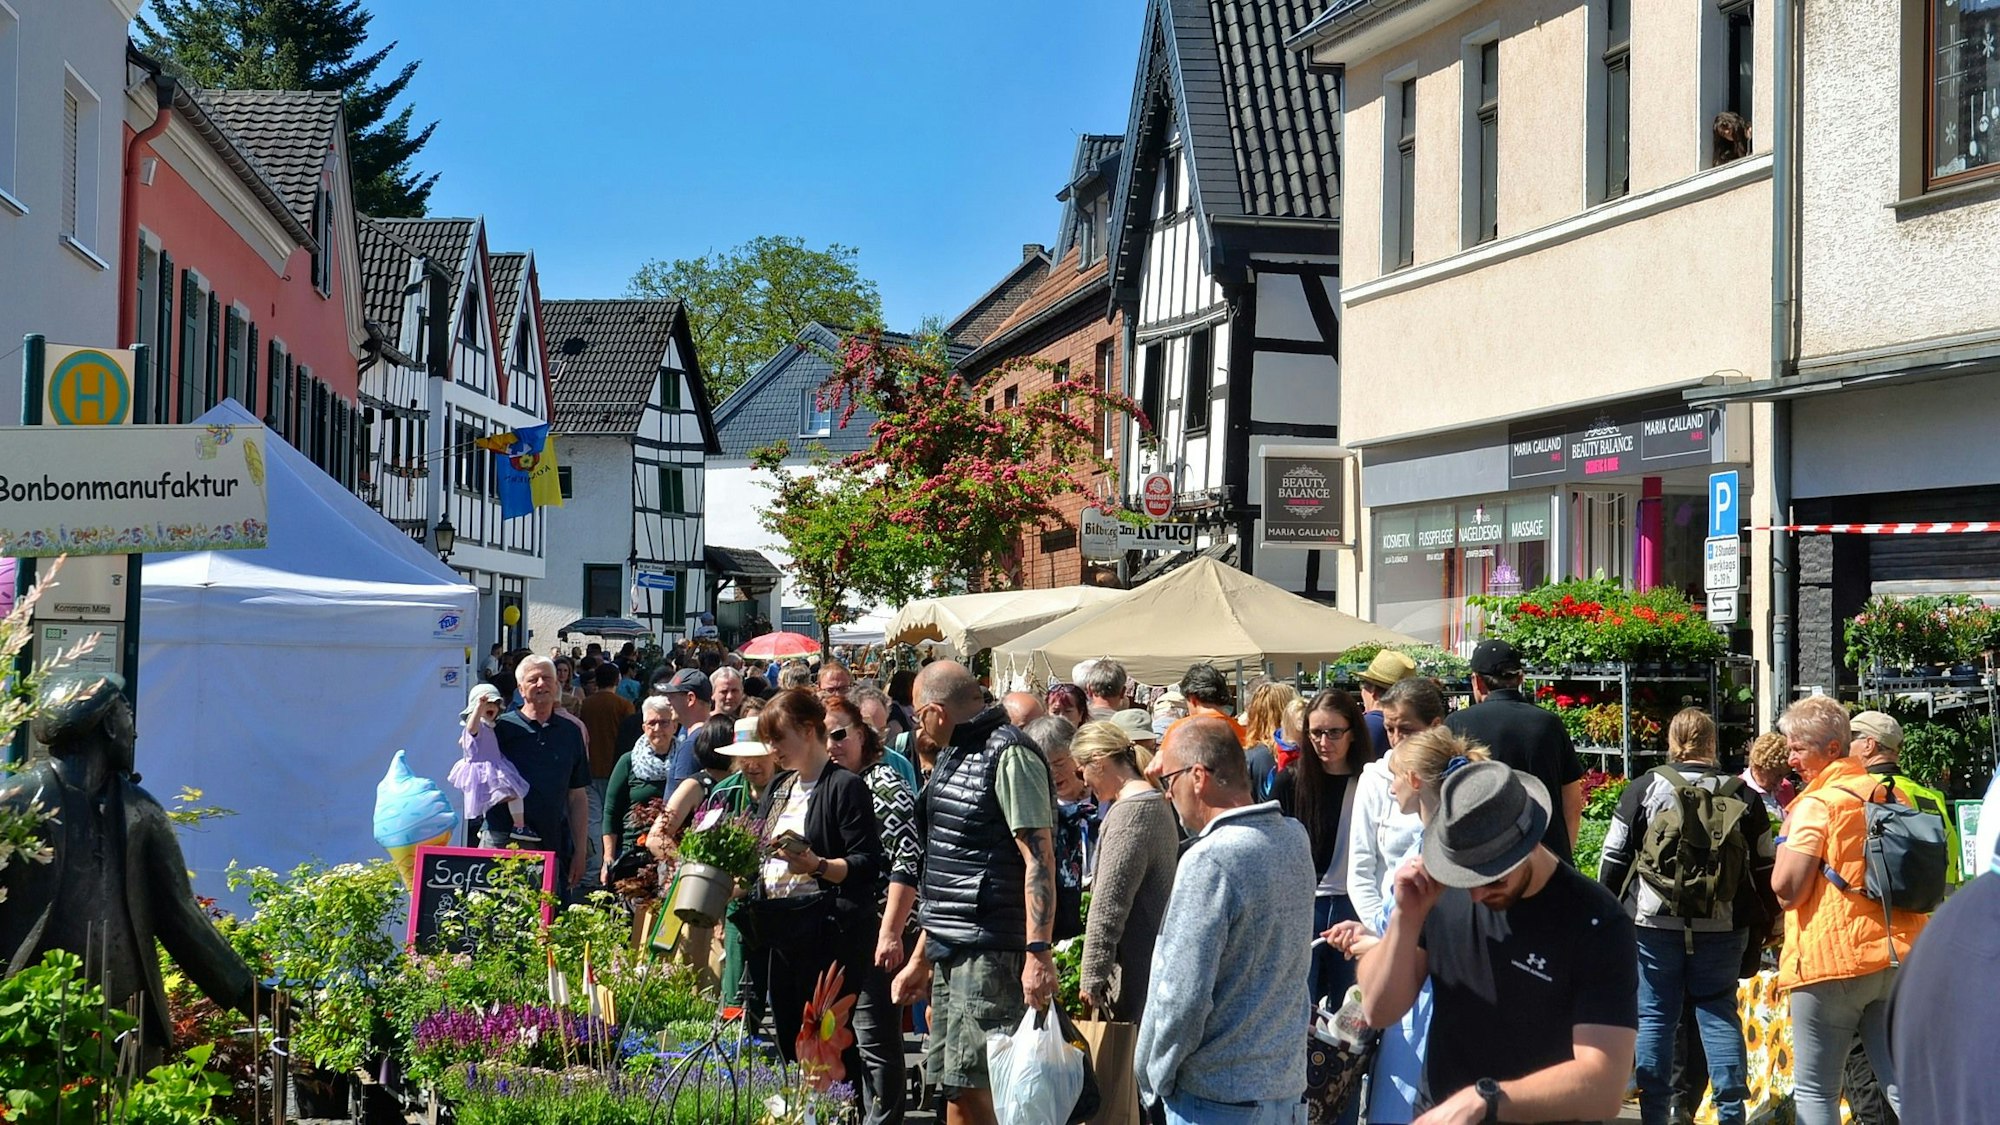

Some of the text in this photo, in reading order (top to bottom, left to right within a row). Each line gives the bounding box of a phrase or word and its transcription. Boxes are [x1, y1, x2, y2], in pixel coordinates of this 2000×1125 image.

[75, 371, 105, 421] H
[1645, 414, 1704, 436] MARIA GALLAND
[1513, 437, 1562, 457] MARIA GALLAND
[1572, 436, 1633, 459] BEAUTY BALANCE
[0, 471, 239, 502] Bonbonmanufaktur
[1278, 488, 1330, 498] BALANCE
[1282, 478, 1327, 488] BEAUTY
[1715, 481, 1732, 531] P
[1136, 524, 1193, 545] Krug
[1267, 528, 1340, 537] MARIA GALLAND
[1383, 520, 1544, 549] KOSMETIK FUSSPFLEGE NAGELDESIGN MASSAGE
[1719, 544, 1736, 557] Stunden
[1709, 560, 1736, 573] werktags
[54, 603, 111, 614] Kommern Mitte
